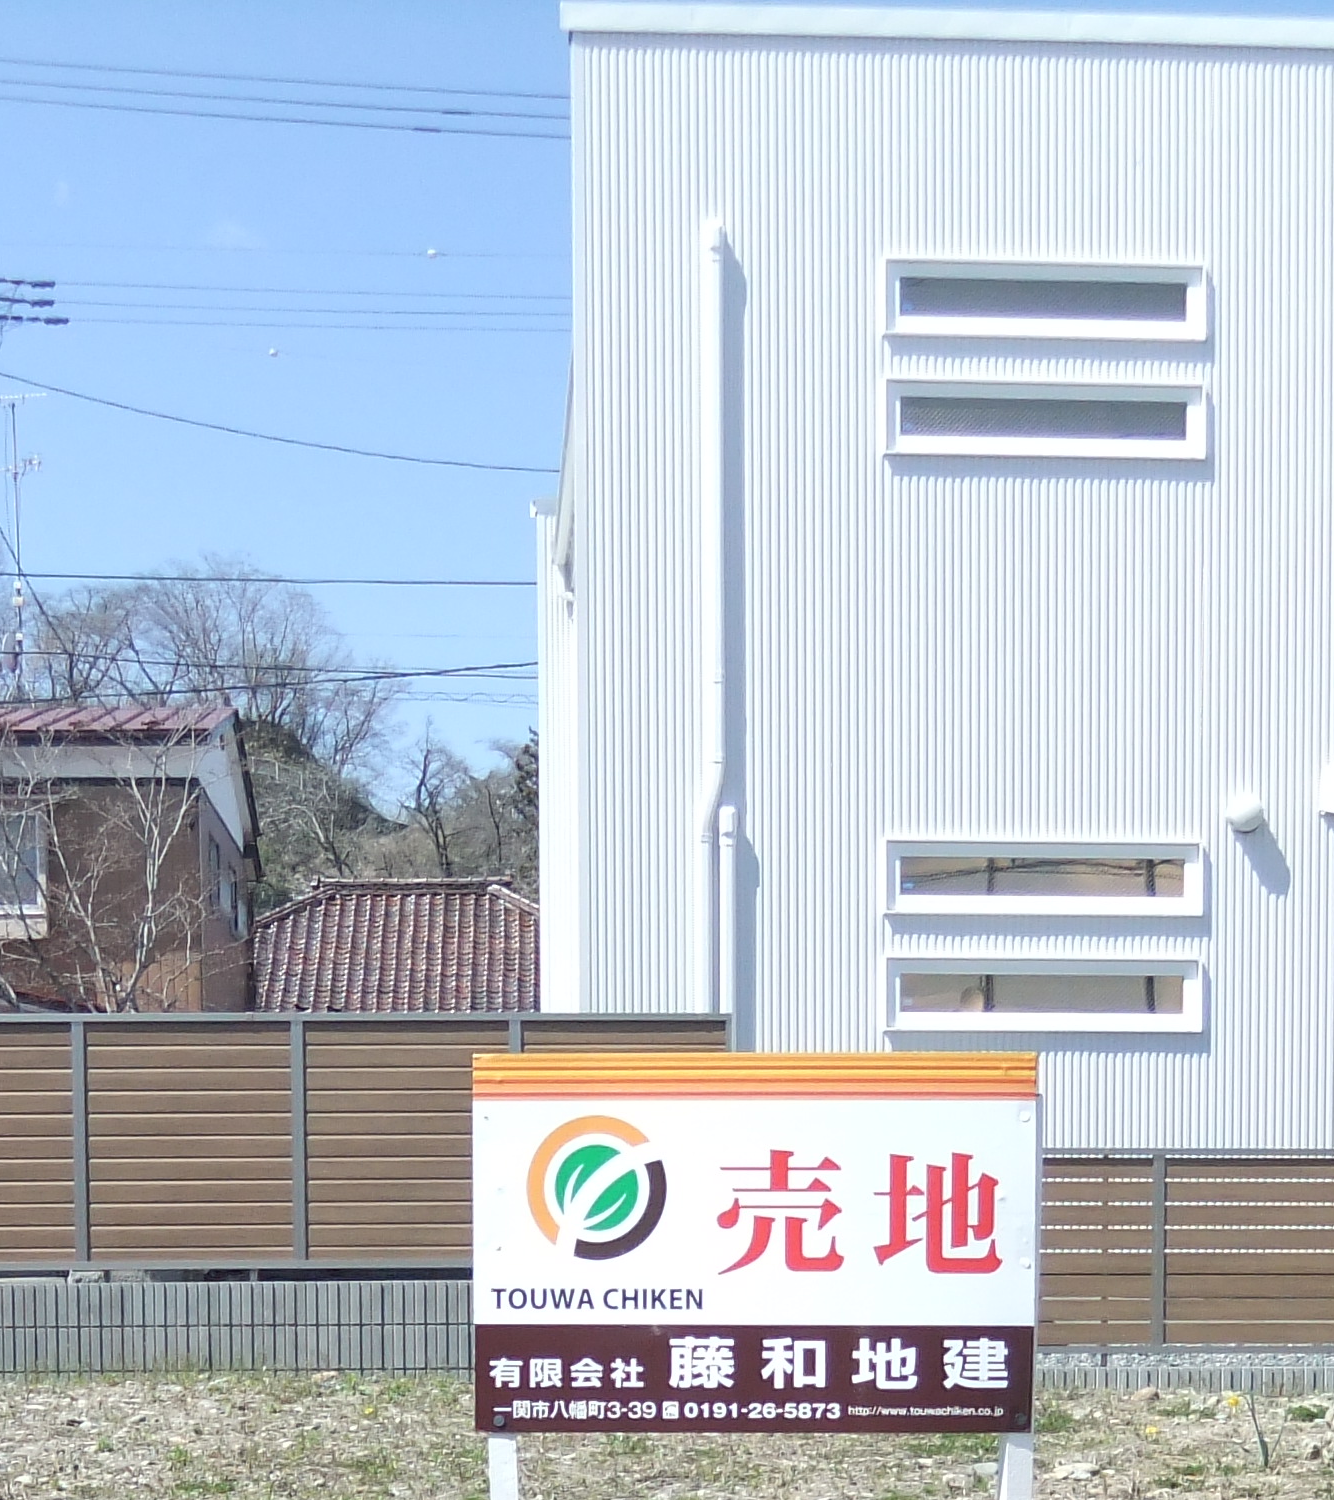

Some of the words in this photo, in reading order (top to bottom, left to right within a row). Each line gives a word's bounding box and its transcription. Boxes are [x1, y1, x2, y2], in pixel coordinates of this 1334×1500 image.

[717, 1149, 1003, 1275] 売地
[491, 1288, 595, 1310] TOUWA
[603, 1288, 704, 1310] CHIKEN
[489, 1357, 645, 1389] 有限会社
[668, 1336, 1009, 1390] 藤和地建
[493, 1400, 657, 1420] 一関市八幡町3-39
[683, 1401, 841, 1420] 0191-26-5873
